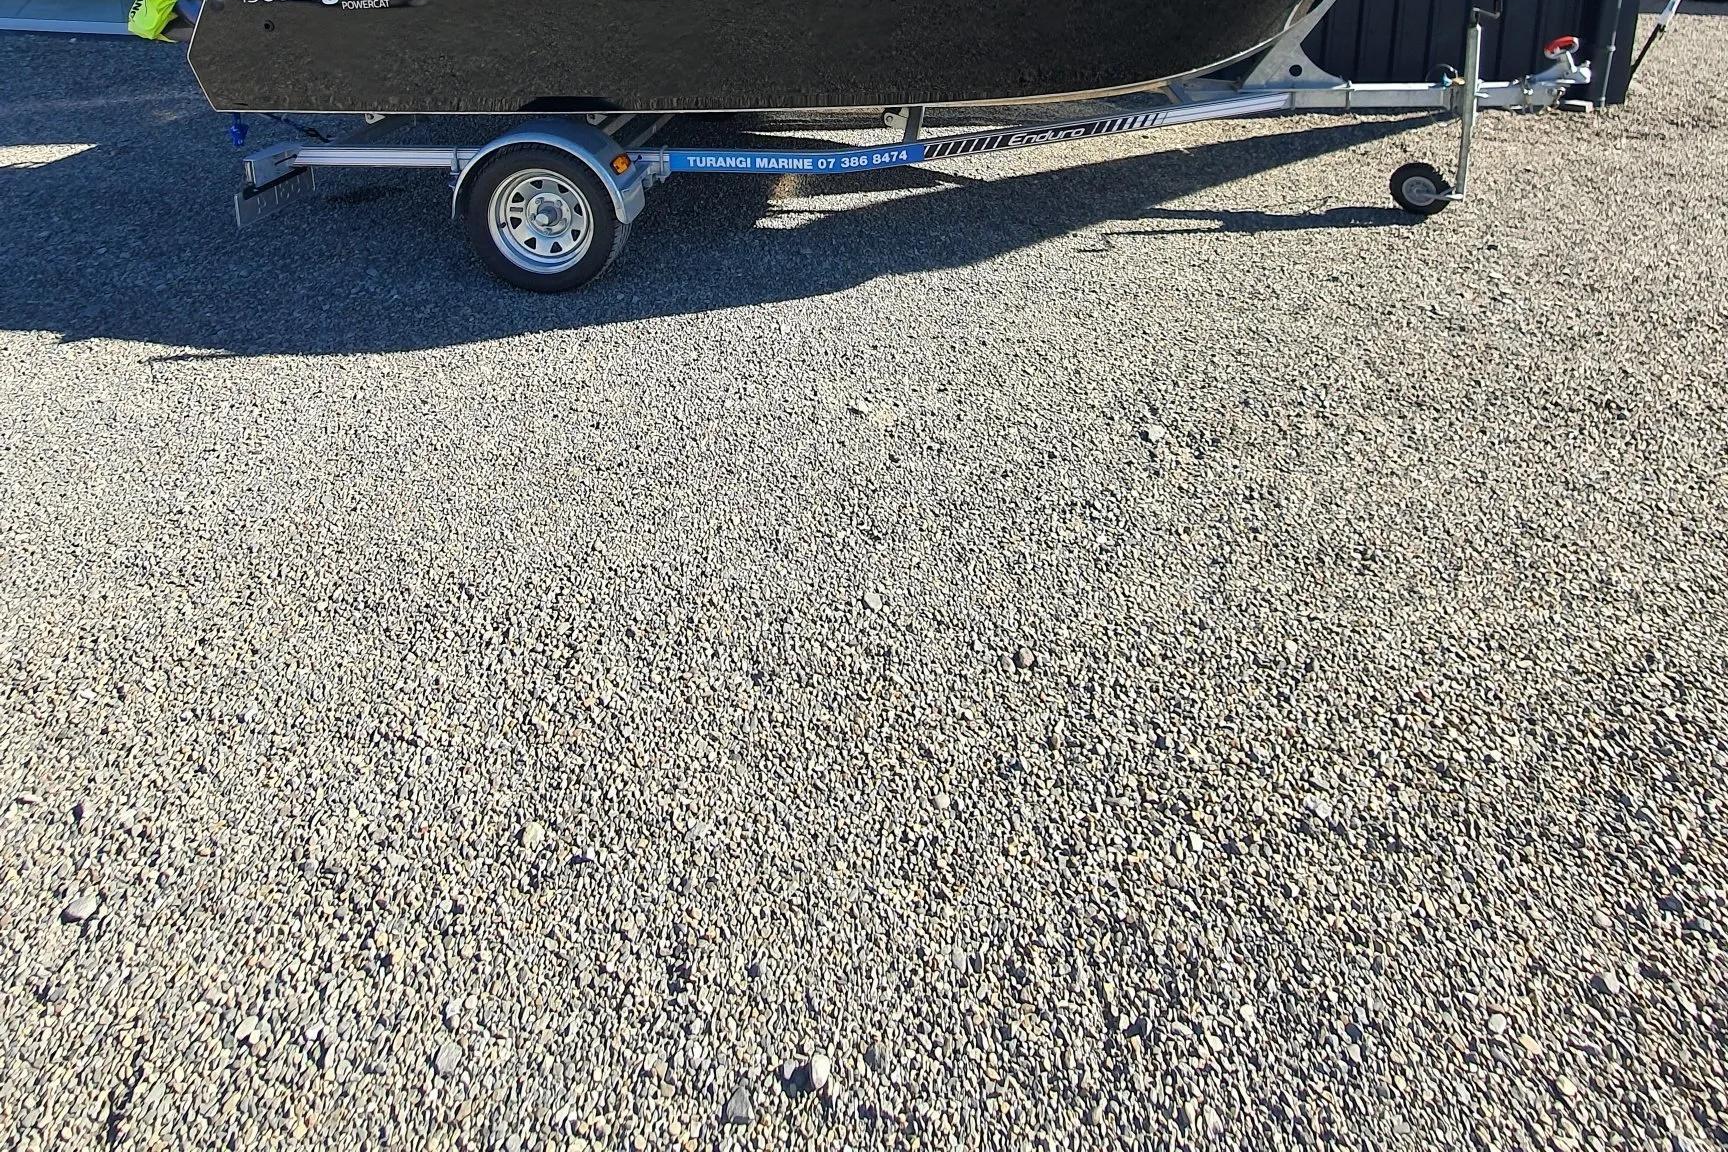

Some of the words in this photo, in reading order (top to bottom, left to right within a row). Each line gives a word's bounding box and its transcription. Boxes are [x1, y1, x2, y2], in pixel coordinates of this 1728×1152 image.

[341, 0, 390, 10] POWERCAT
[1008, 128, 1085, 145] Enduro
[687, 156, 750, 168] TURANGI
[756, 158, 813, 170] MARINE
[817, 157, 835, 169] 07
[841, 155, 868, 167] 386
[872, 150, 907, 165] 8474
